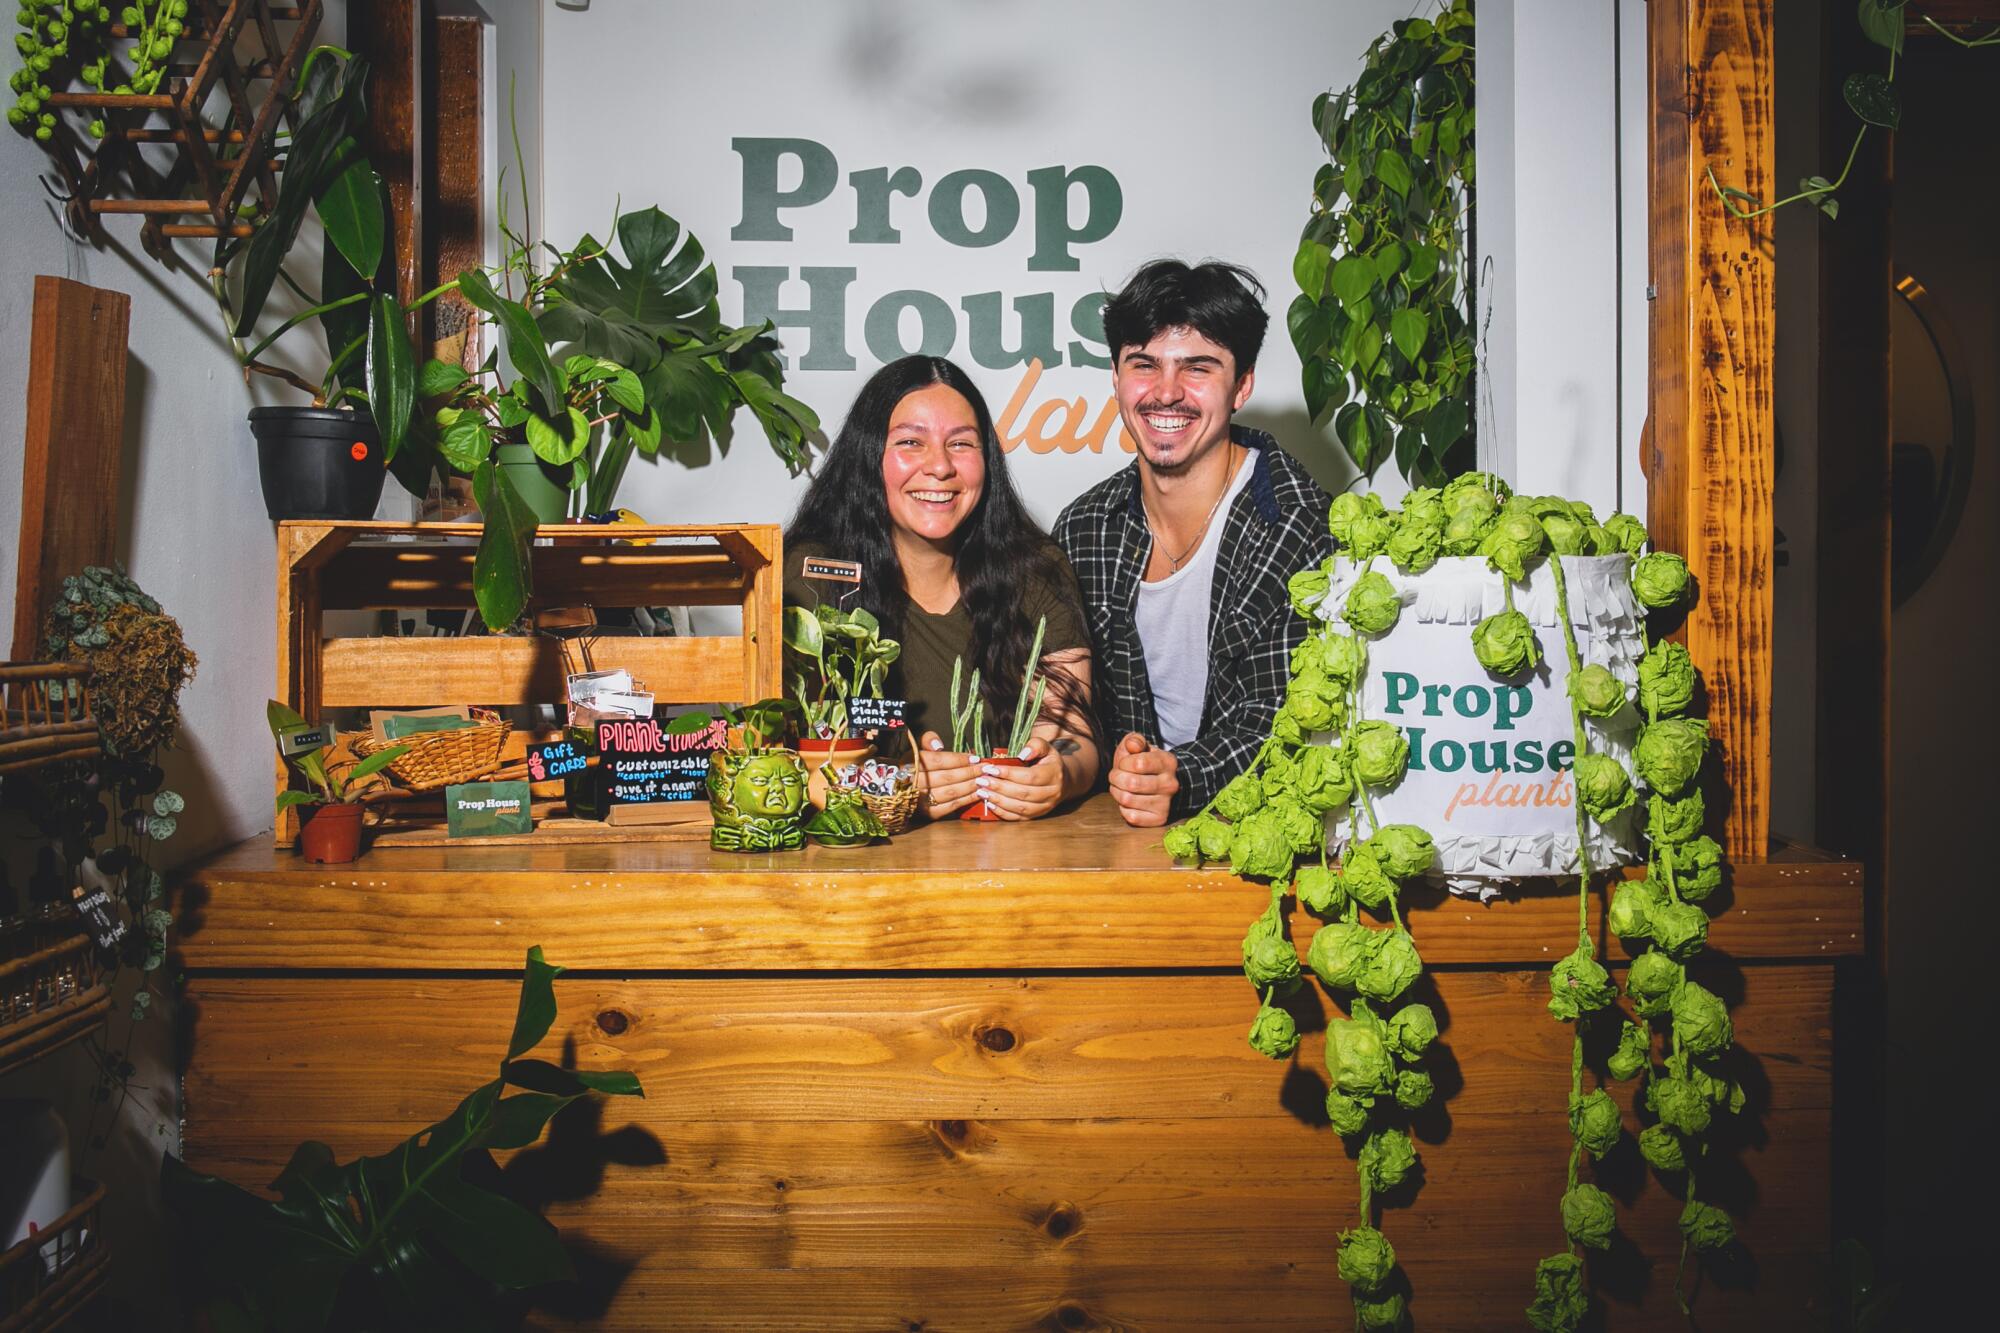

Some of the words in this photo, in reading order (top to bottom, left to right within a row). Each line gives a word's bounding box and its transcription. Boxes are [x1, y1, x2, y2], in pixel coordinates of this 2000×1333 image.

[731, 137, 1123, 272] Prop
[733, 265, 1118, 370] Hous
[852, 697, 872, 707] Buy
[877, 699, 906, 709] your
[1382, 671, 1534, 730] Prop
[853, 715, 888, 726] drink
[550, 755, 587, 776] CARDS
[614, 783, 643, 798] give
[1444, 767, 1573, 821] plants
[457, 800, 486, 811] Prop
[486, 798, 521, 809] House
